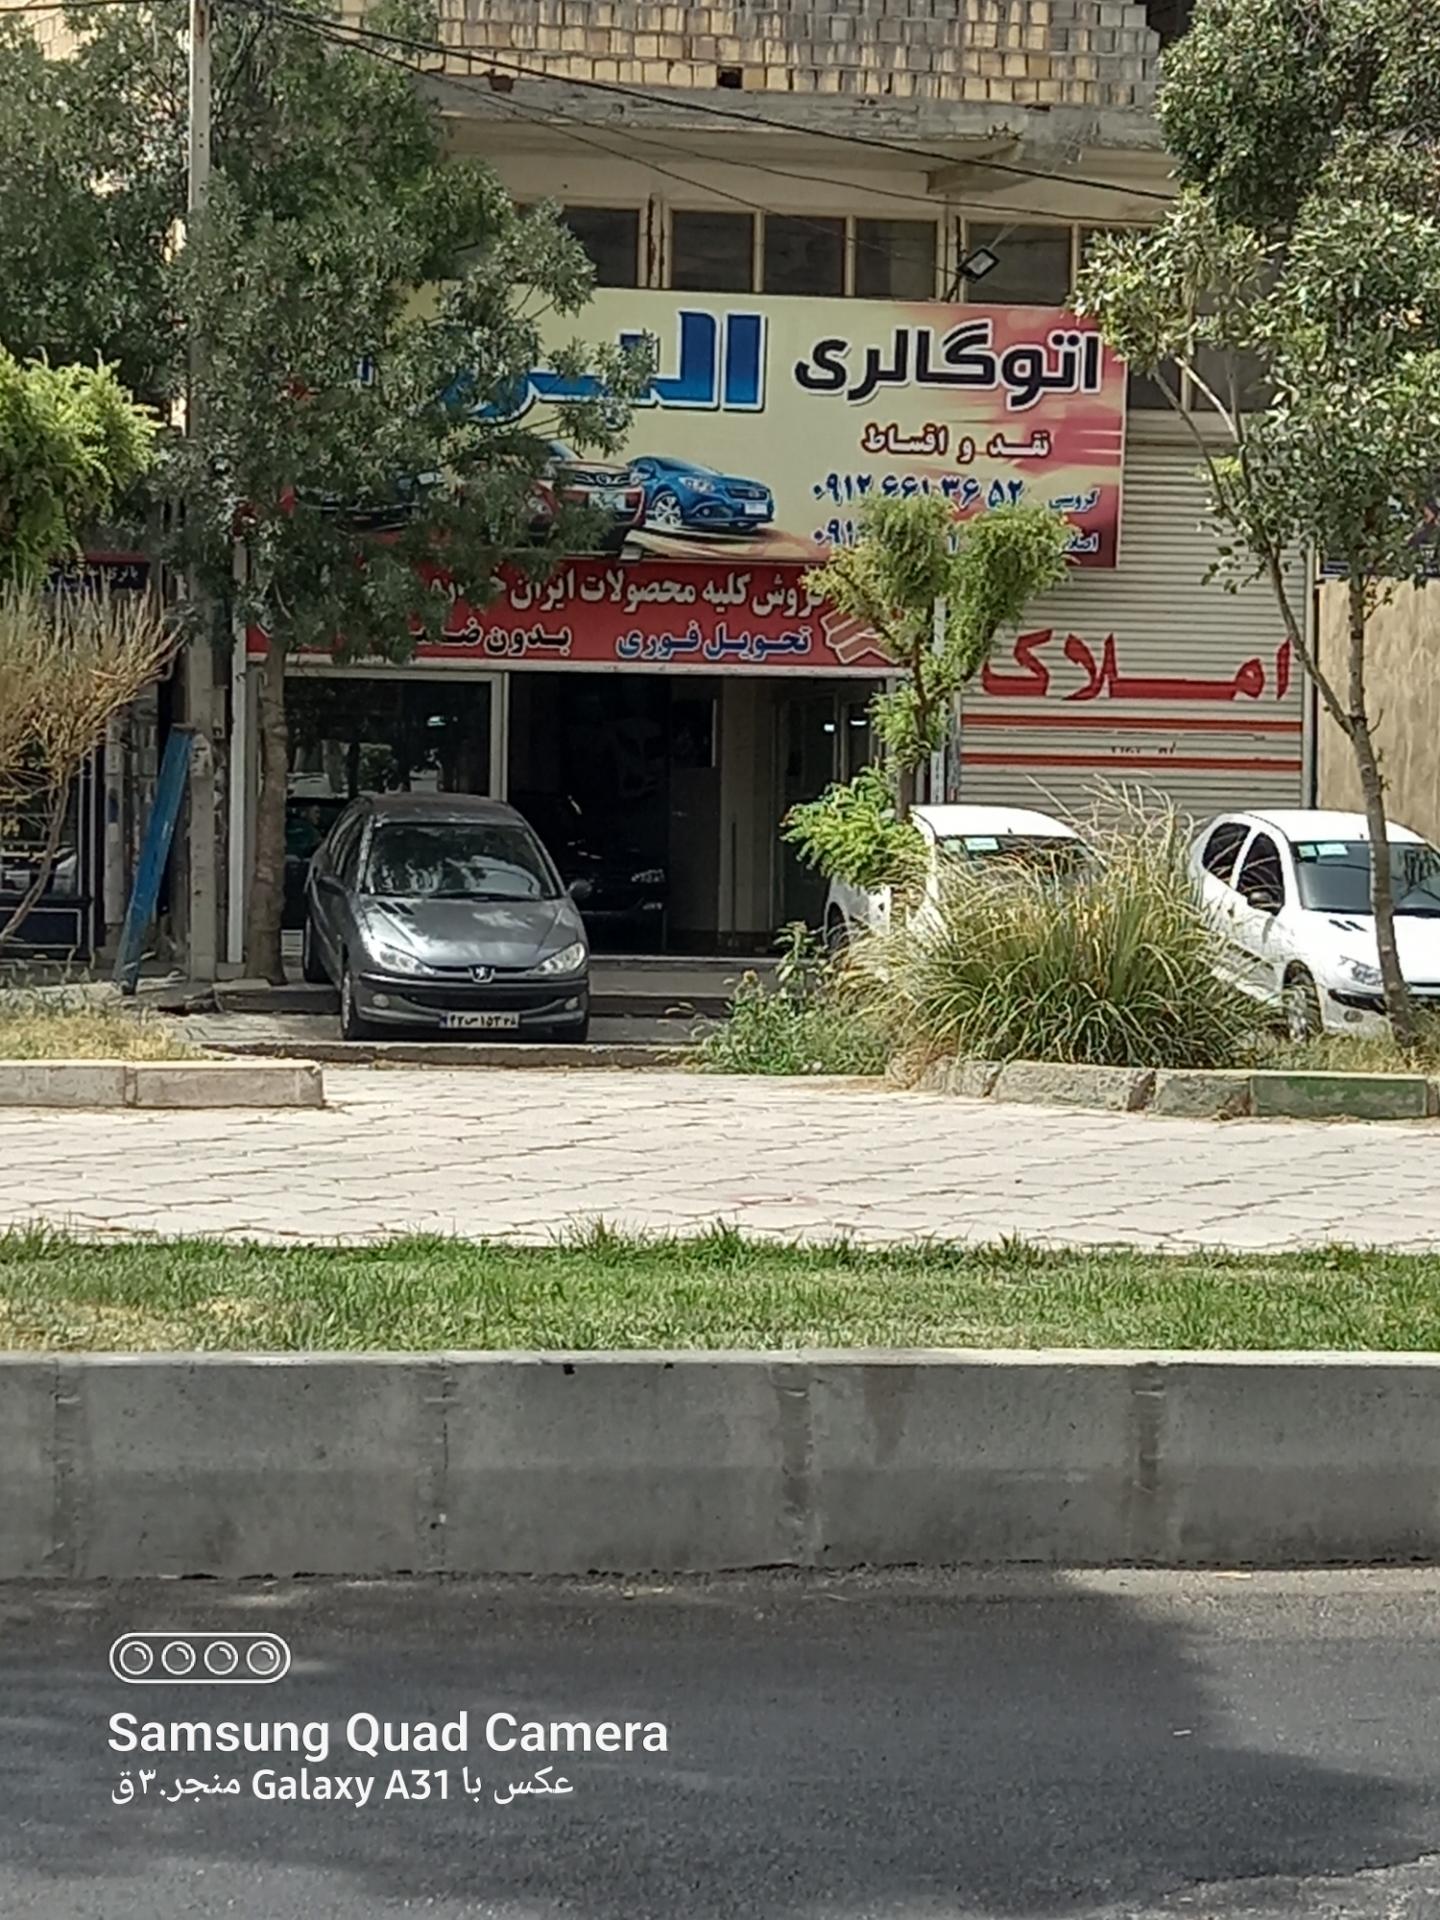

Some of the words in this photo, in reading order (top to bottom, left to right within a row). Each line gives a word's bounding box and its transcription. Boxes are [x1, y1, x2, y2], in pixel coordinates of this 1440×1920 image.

[793, 318, 1101, 411] اتوگالری
[861, 421, 949, 455] اقساط
[957, 437, 976, 464] و
[987, 430, 1050, 459] نقد
[510, 567, 576, 611] ایران
[580, 567, 697, 613] محصولات
[702, 571, 752, 613] کلیه
[484, 623, 574, 656] بدون
[615, 619, 702, 661] فوری
[702, 621, 813, 664] تحویل
[981, 628, 1293, 701] املاک
